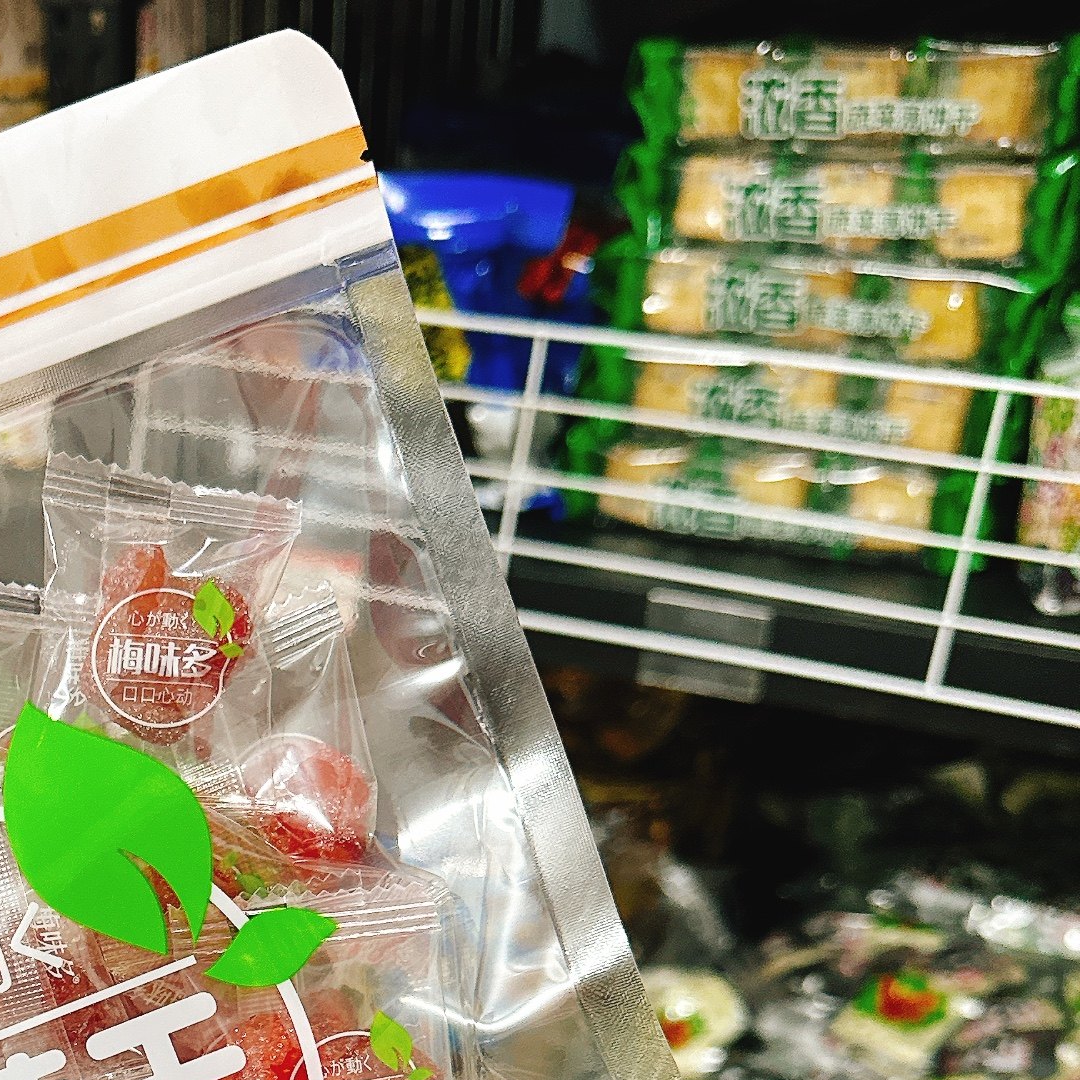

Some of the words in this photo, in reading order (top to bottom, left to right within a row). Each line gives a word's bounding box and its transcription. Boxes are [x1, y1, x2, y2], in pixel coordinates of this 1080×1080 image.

[106, 637, 218, 679] 梅味多
[123, 685, 194, 707] 口口心动
